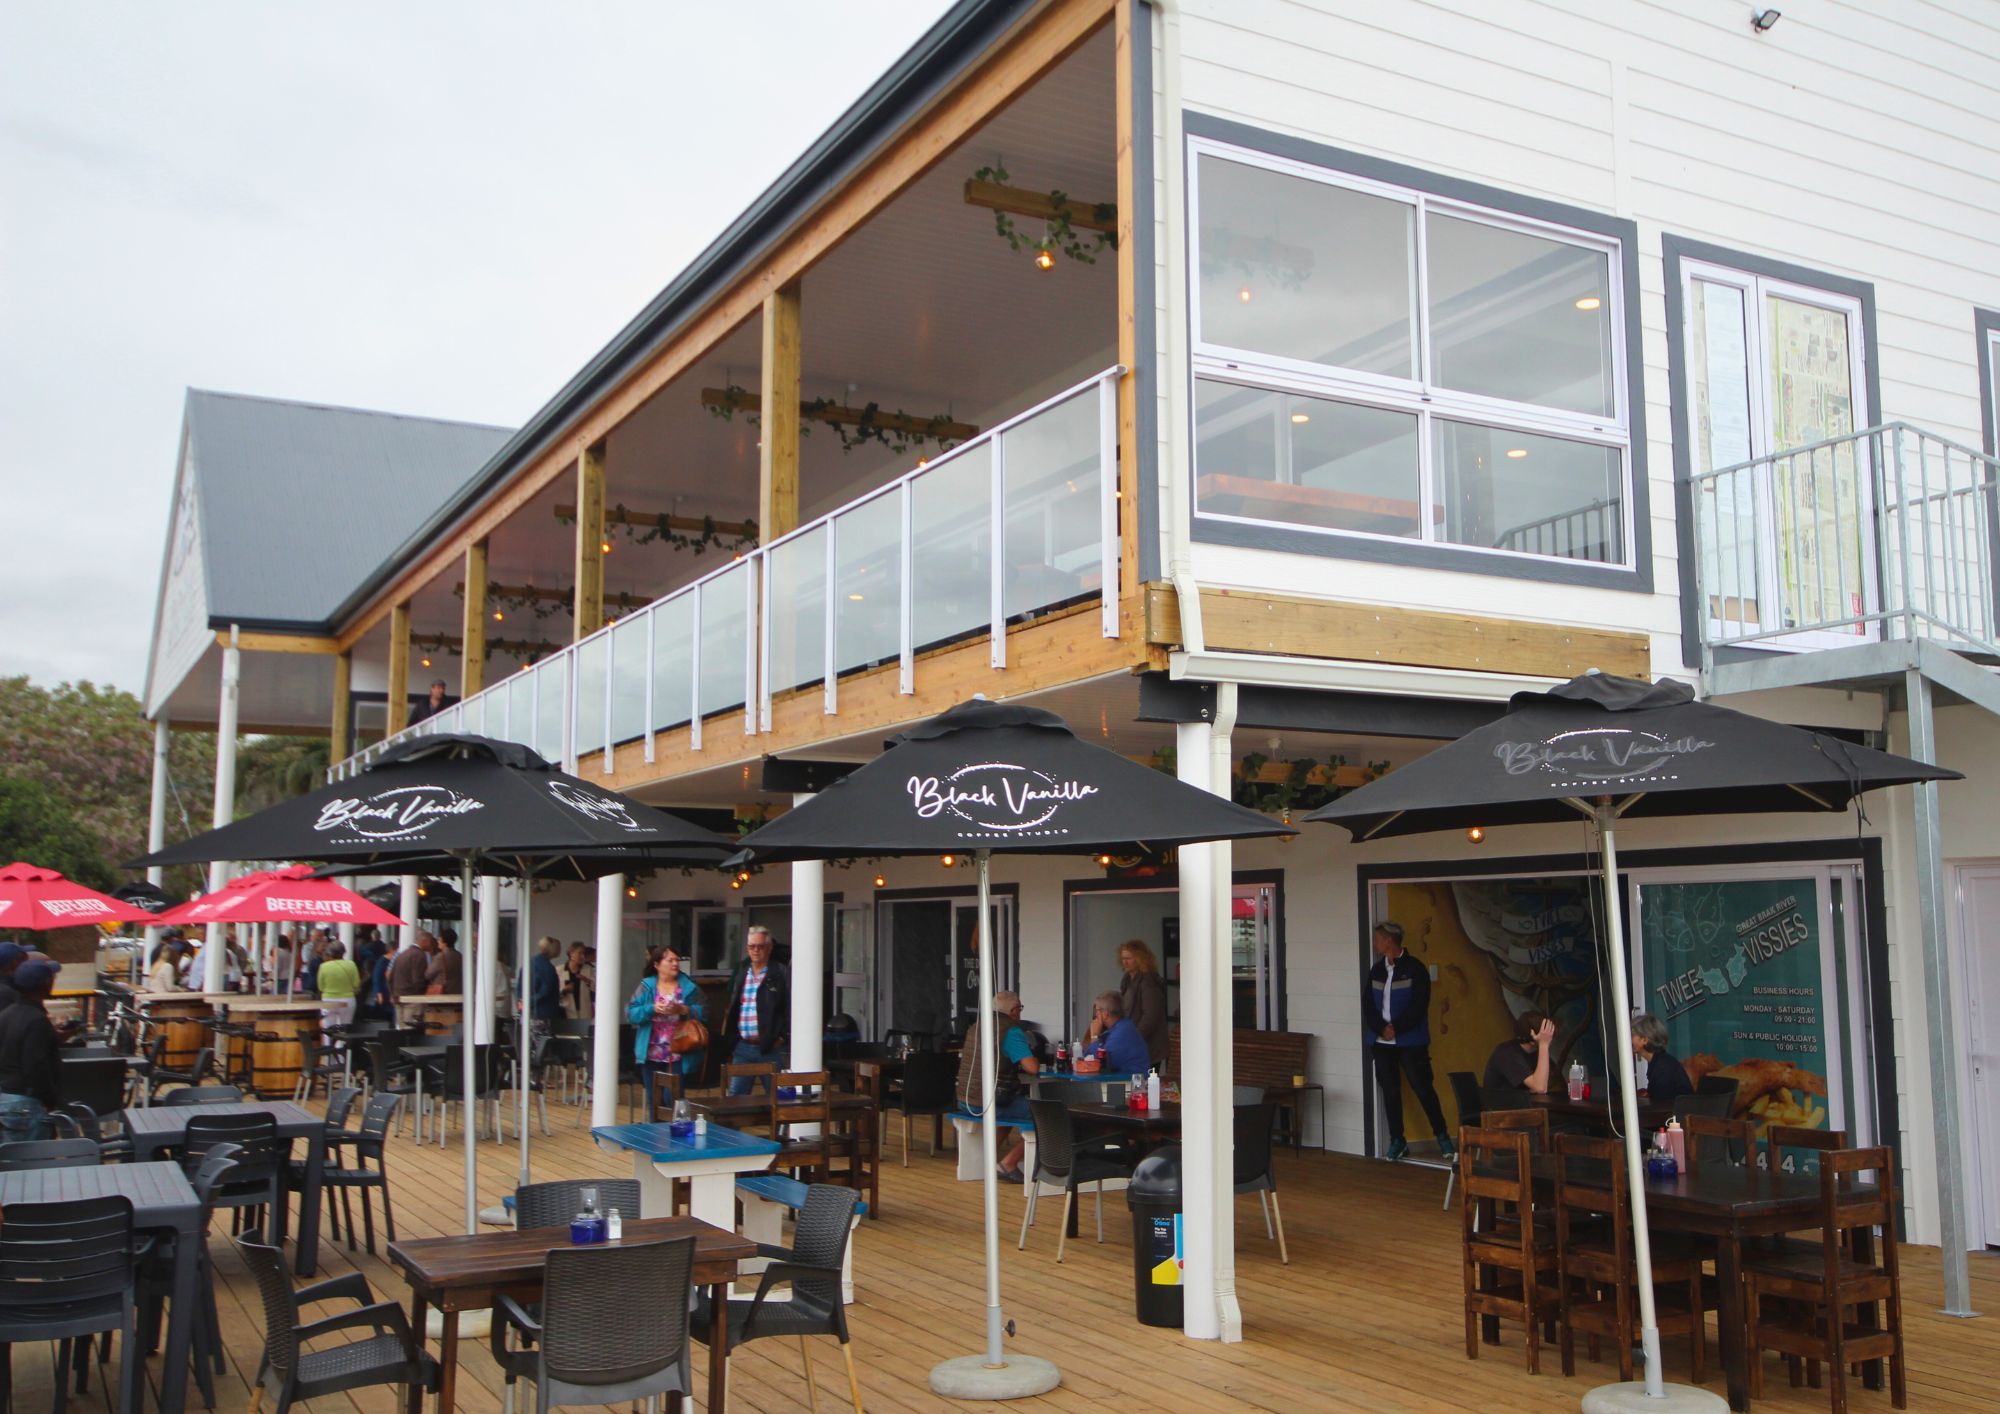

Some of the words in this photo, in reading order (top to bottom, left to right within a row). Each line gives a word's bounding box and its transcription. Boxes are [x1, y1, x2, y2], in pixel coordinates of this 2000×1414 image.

[1494, 740, 1597, 775] Black
[1604, 736, 1716, 767] Vanilla
[906, 776, 997, 818] Black
[1001, 777, 1099, 815] Vanilla
[313, 798, 399, 831] Black
[398, 795, 486, 826] Vanilla
[1018, 828, 1069, 837] STUDIO
[38, 898, 116, 917] BEEFEATER
[265, 896, 354, 916] BEEFEATER
[1736, 912, 1759, 934] GREAT
[1757, 905, 1777, 923] BRAK
[1775, 895, 1797, 914] RIVER
[1742, 912, 1809, 965] VISSIES
[1656, 968, 1704, 1011] TWEE
[1753, 986, 1788, 995] BUSINESS
[1789, 988, 1814, 996] HOURS
[1743, 1004, 1773, 1012] MONDAY
[1778, 1006, 1815, 1014] SATURDAY
[1797, 1016, 1816, 1024] 21:00
[1733, 1031, 1748, 1039] SUN
[1755, 1033, 1780, 1041] PUBLIC
[1781, 1034, 1817, 1043] HOLIDAYS
[1776, 1043, 1794, 1051] 10:00
